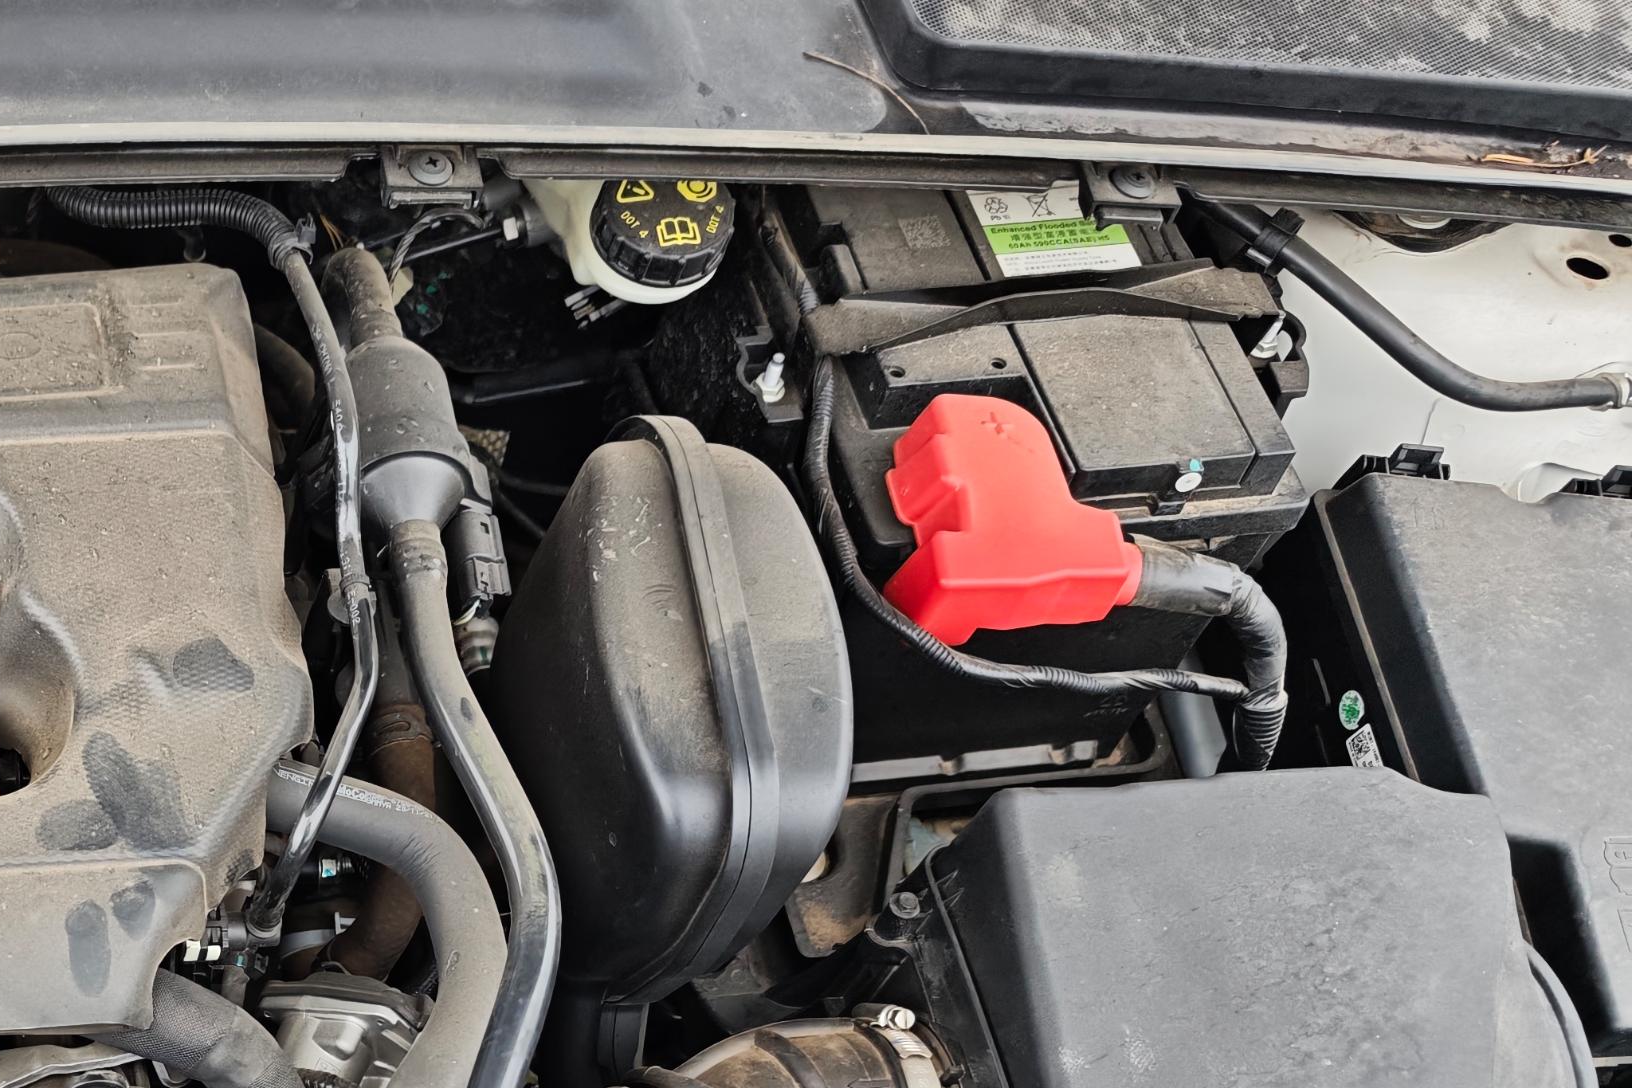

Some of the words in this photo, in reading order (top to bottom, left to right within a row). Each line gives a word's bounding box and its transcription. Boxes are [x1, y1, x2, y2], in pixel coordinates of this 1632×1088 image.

[620, 210, 641, 229] DOT
[639, 230, 649, 239] 4
[705, 213, 721, 234] DOT
[715, 204, 725, 214] 4
[990, 225, 1037, 235] Enhanced
[1038, 220, 1078, 231] Flooded
